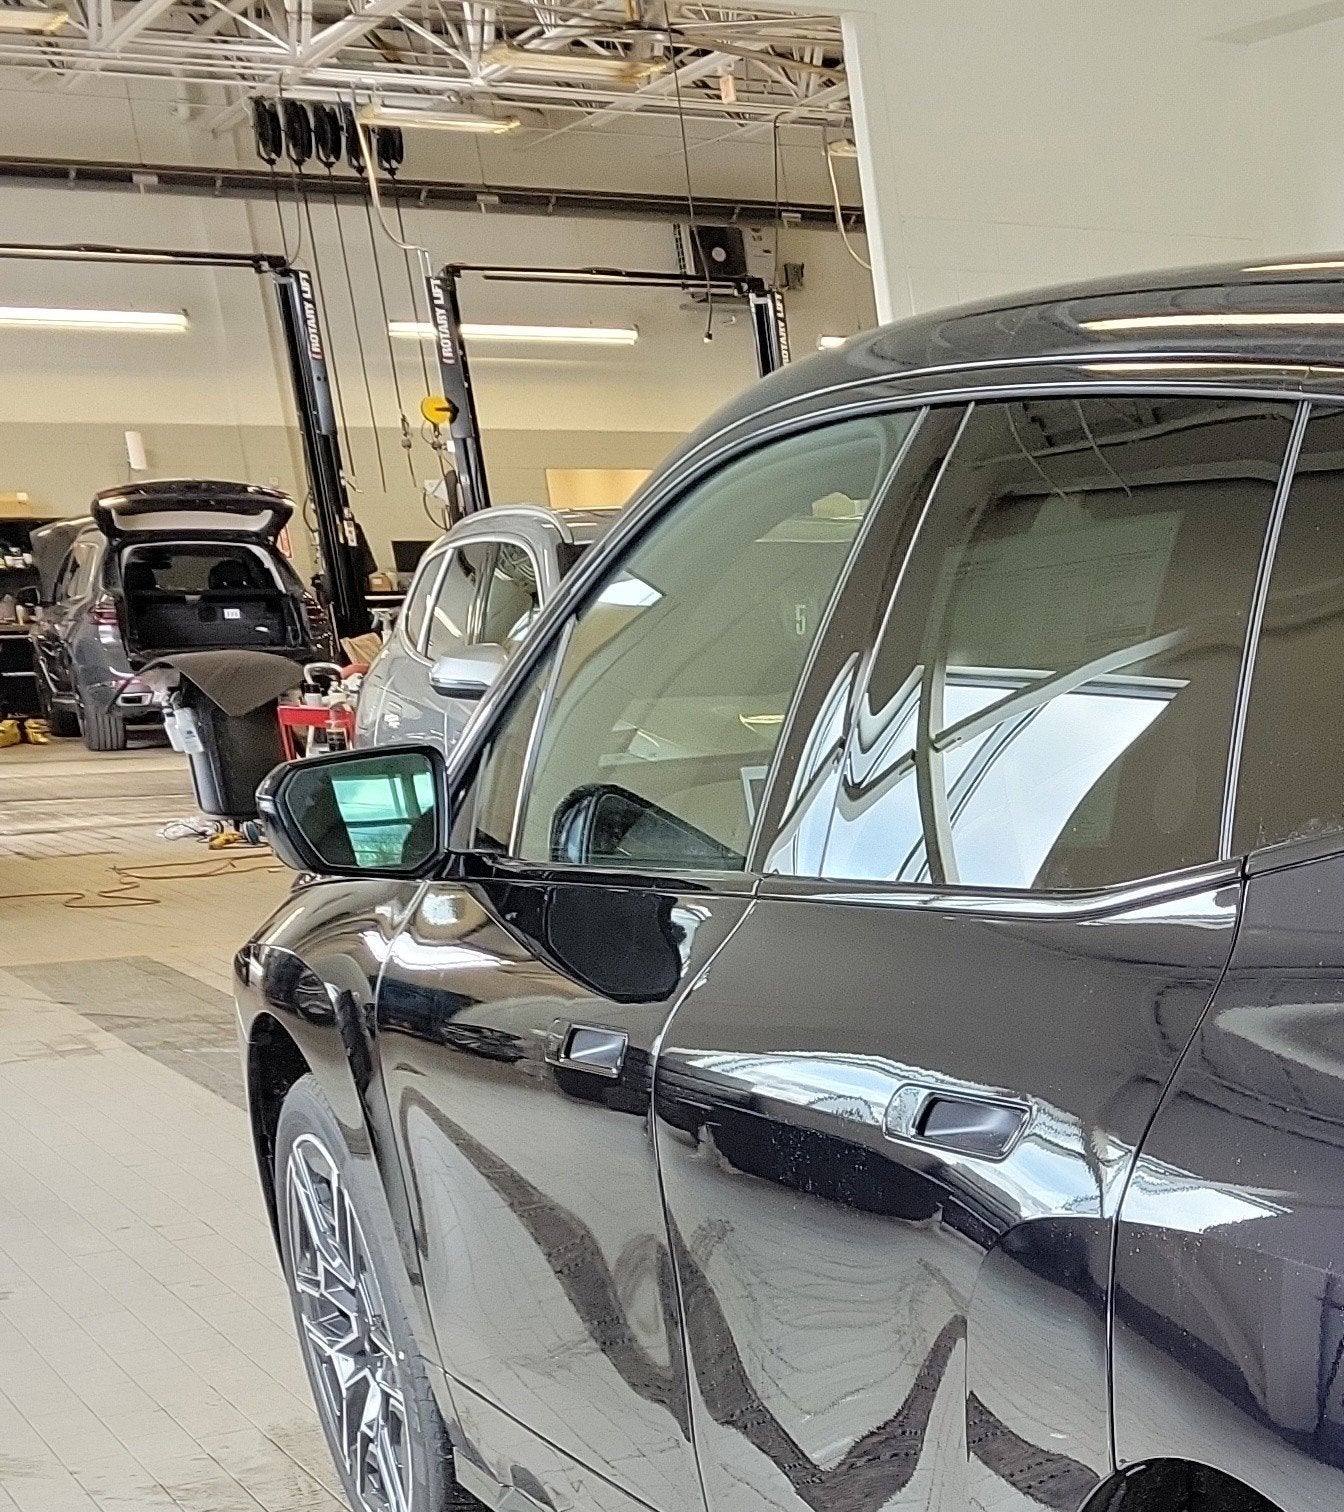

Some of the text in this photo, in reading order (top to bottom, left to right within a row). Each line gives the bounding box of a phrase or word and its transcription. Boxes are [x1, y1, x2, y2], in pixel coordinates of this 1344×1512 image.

[299, 271, 322, 353] ROTARY LIFT
[430, 278, 455, 358] ROTARY LIFT
